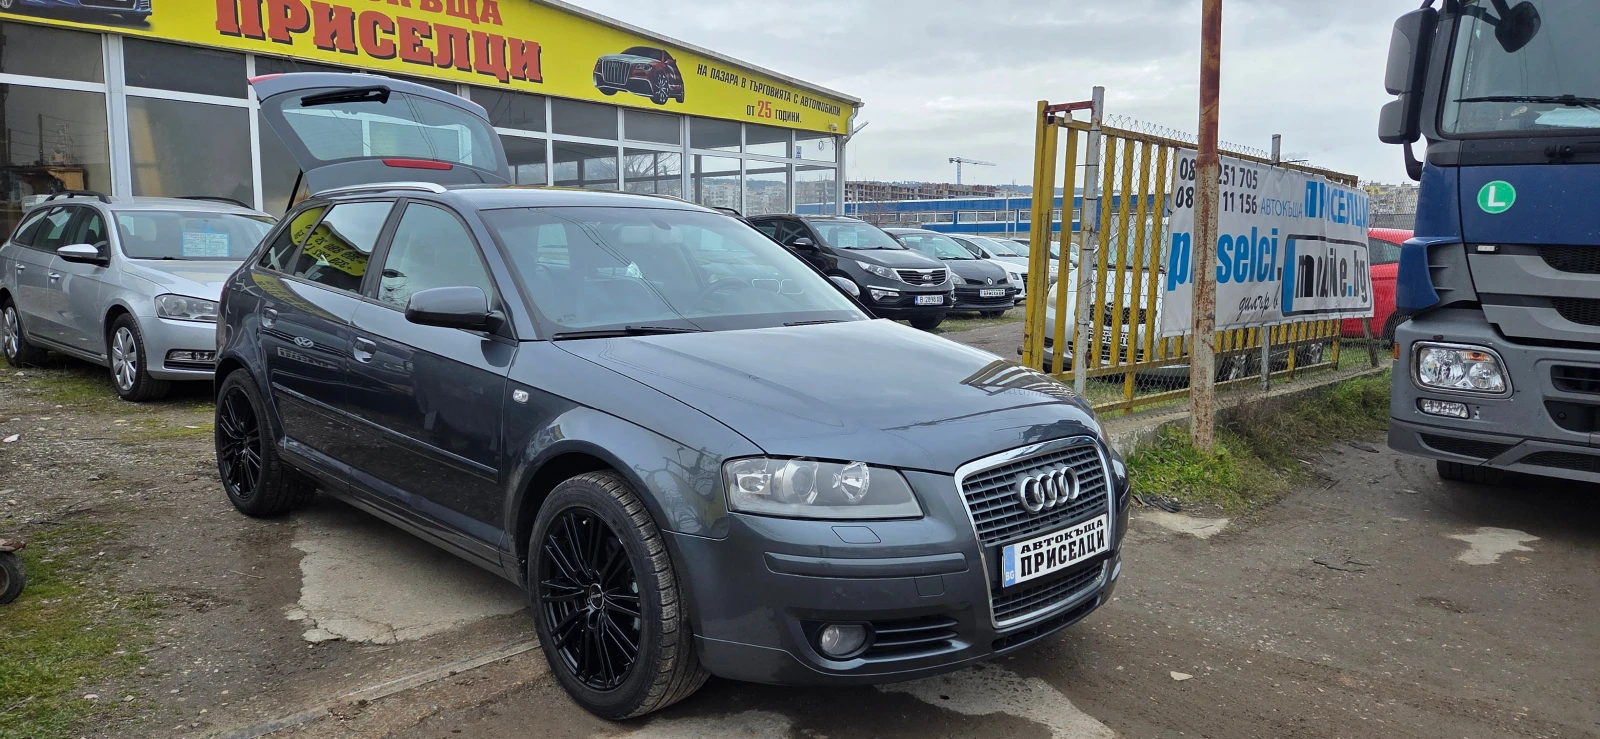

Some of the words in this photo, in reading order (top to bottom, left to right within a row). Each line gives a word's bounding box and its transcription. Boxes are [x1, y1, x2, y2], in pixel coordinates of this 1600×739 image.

[215, 0, 543, 84] ПРИСЕЛЦИ
[696, 63, 707, 77] НА
[710, 67, 739, 87] ПАЗАРА
[741, 77, 747, 89] В
[749, 79, 791, 103] ТЪРГОВИЯТА
[793, 93, 799, 105] С
[800, 95, 841, 117] АВТОМОБИЛИ
[746, 104, 755, 117] ОТ
[757, 99, 772, 119] 25
[775, 108, 802, 124] ГОДИНИ.
[1239, 167, 1259, 190] 705
[1175, 185, 1195, 208] 08
[1222, 190, 1235, 212] 11
[1239, 192, 1258, 215] 156
[1260, 197, 1303, 220] АВТОКЪЩА
[1487, 185, 1506, 207] L
[1167, 226, 1282, 291] pselci.
[1020, 518, 1104, 555] АВТОКЪЩА
[1020, 528, 1105, 578] ПРИСЕЛЦИ
[1005, 569, 1015, 582] BG
